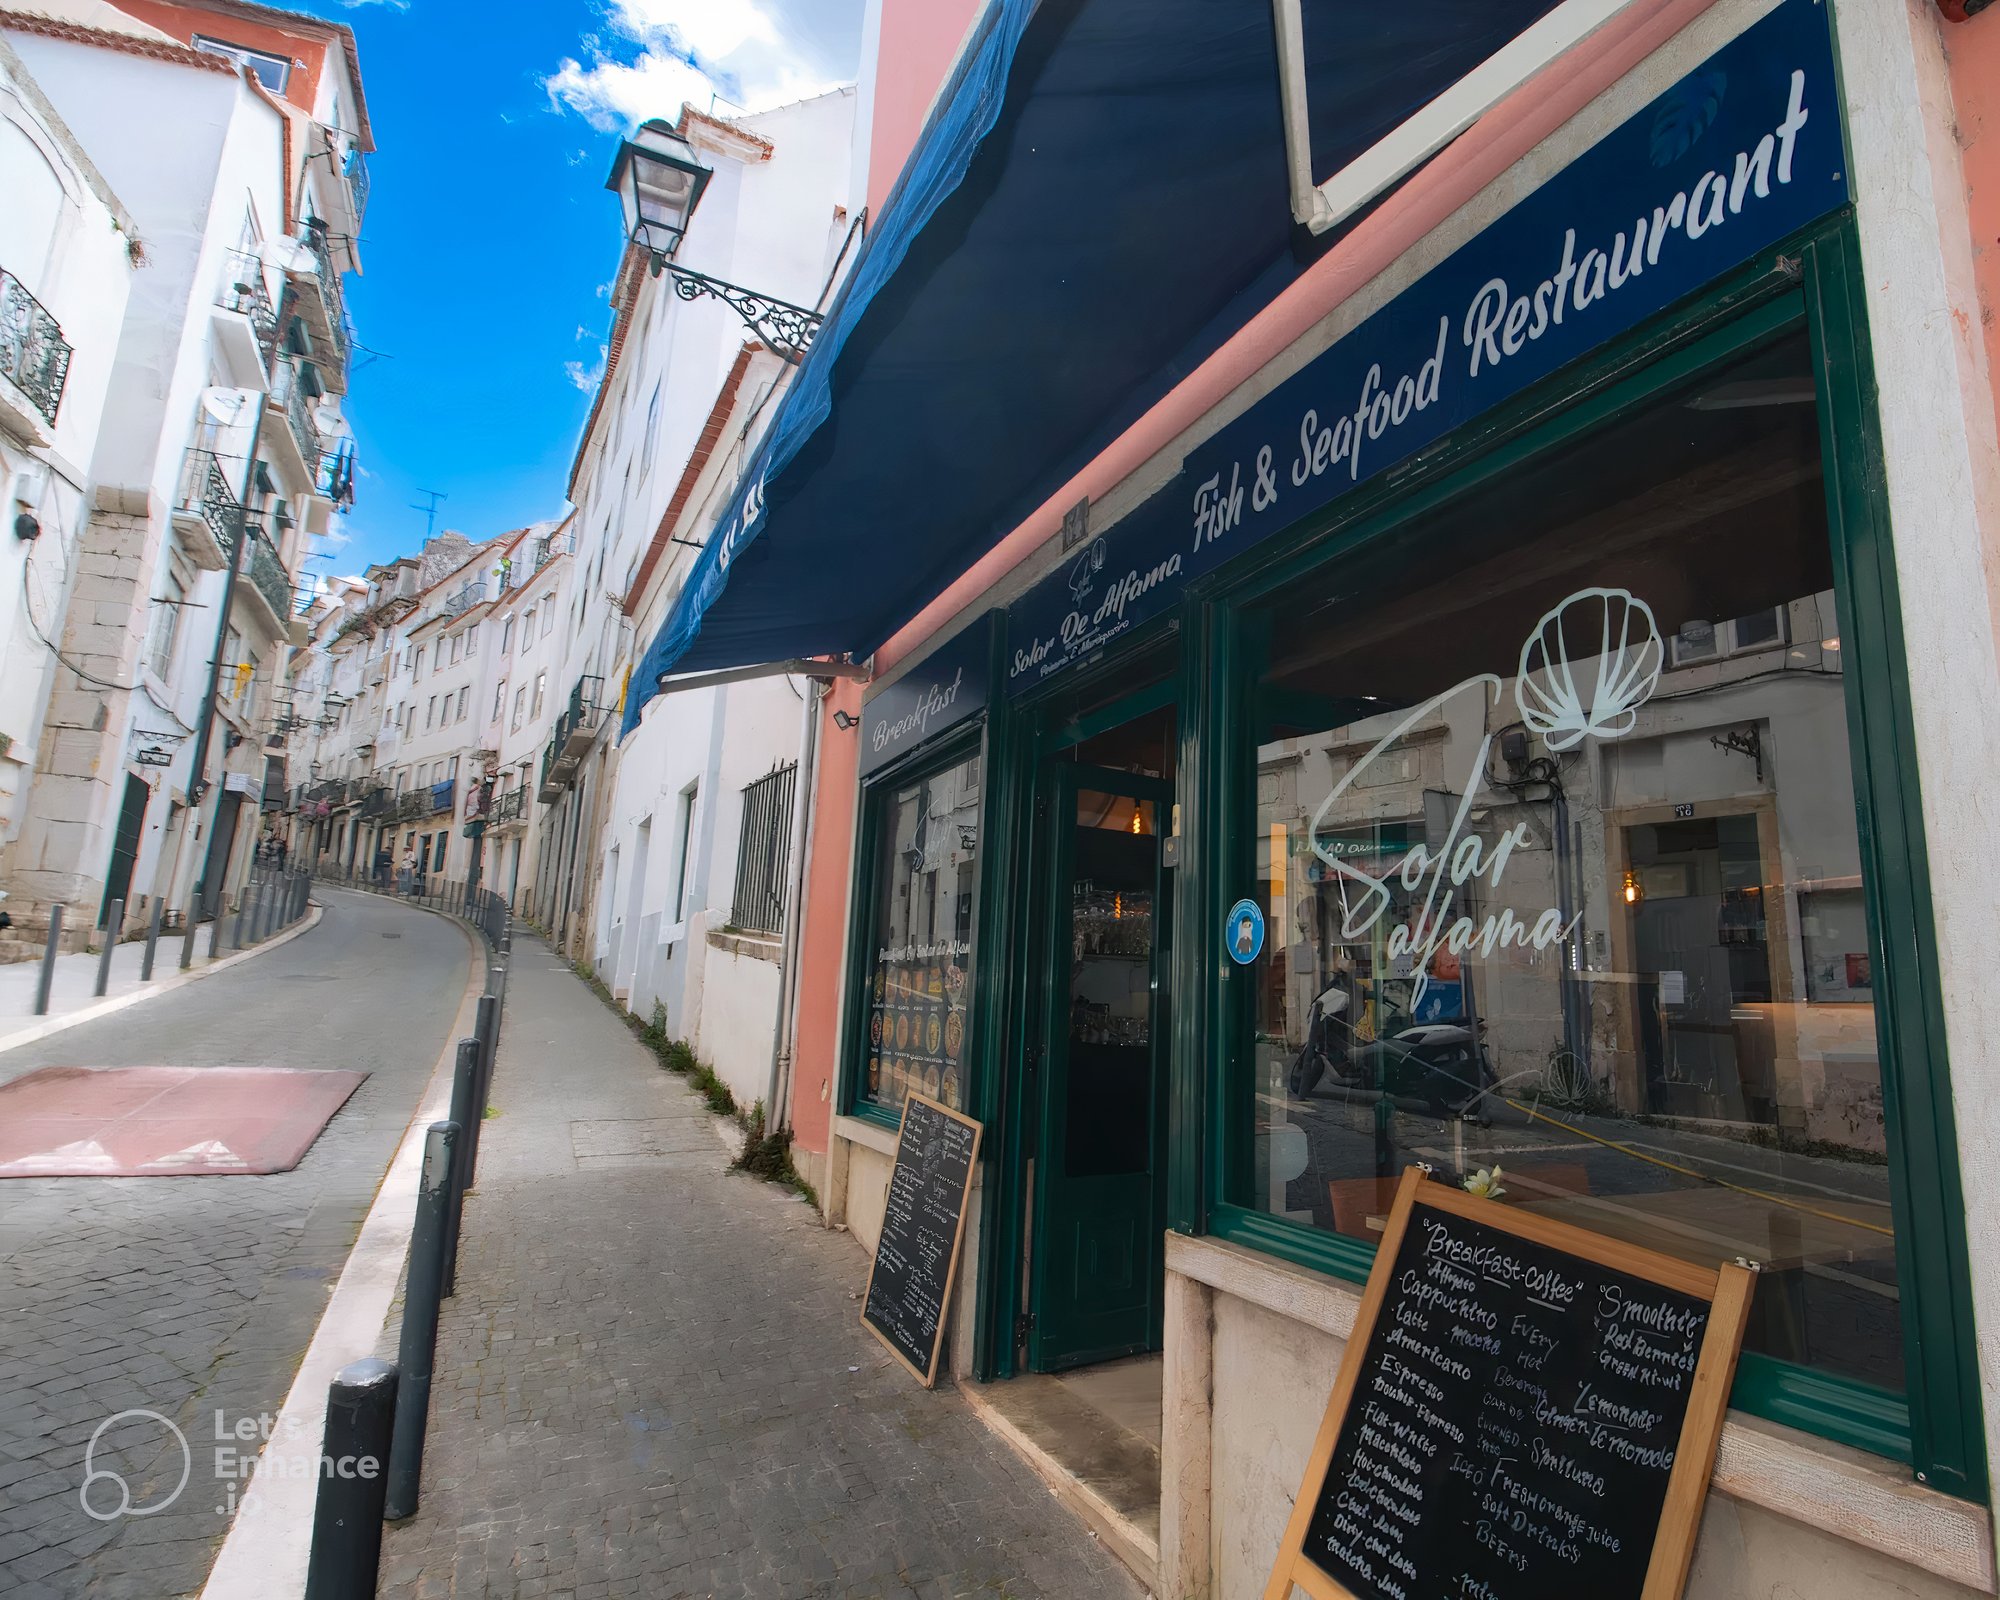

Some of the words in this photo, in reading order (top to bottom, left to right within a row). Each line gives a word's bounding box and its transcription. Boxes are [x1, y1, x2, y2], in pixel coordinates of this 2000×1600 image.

[1192, 462, 1244, 552] Fish
[1251, 443, 1279, 512] &
[1291, 315, 1449, 487] Seafood
[1463, 69, 1809, 378] Restaurant
[1010, 637, 1056, 678] Solar
[1060, 611, 1089, 645] De
[1093, 553, 1182, 620] Alfama
[873, 667, 962, 752] Breakfast
[1307, 672, 1533, 952] Solar
[1386, 1328, 1472, 1380] Americano
[1396, 1300, 1430, 1332] Latte
[1380, 1353, 1444, 1402] Espresso
